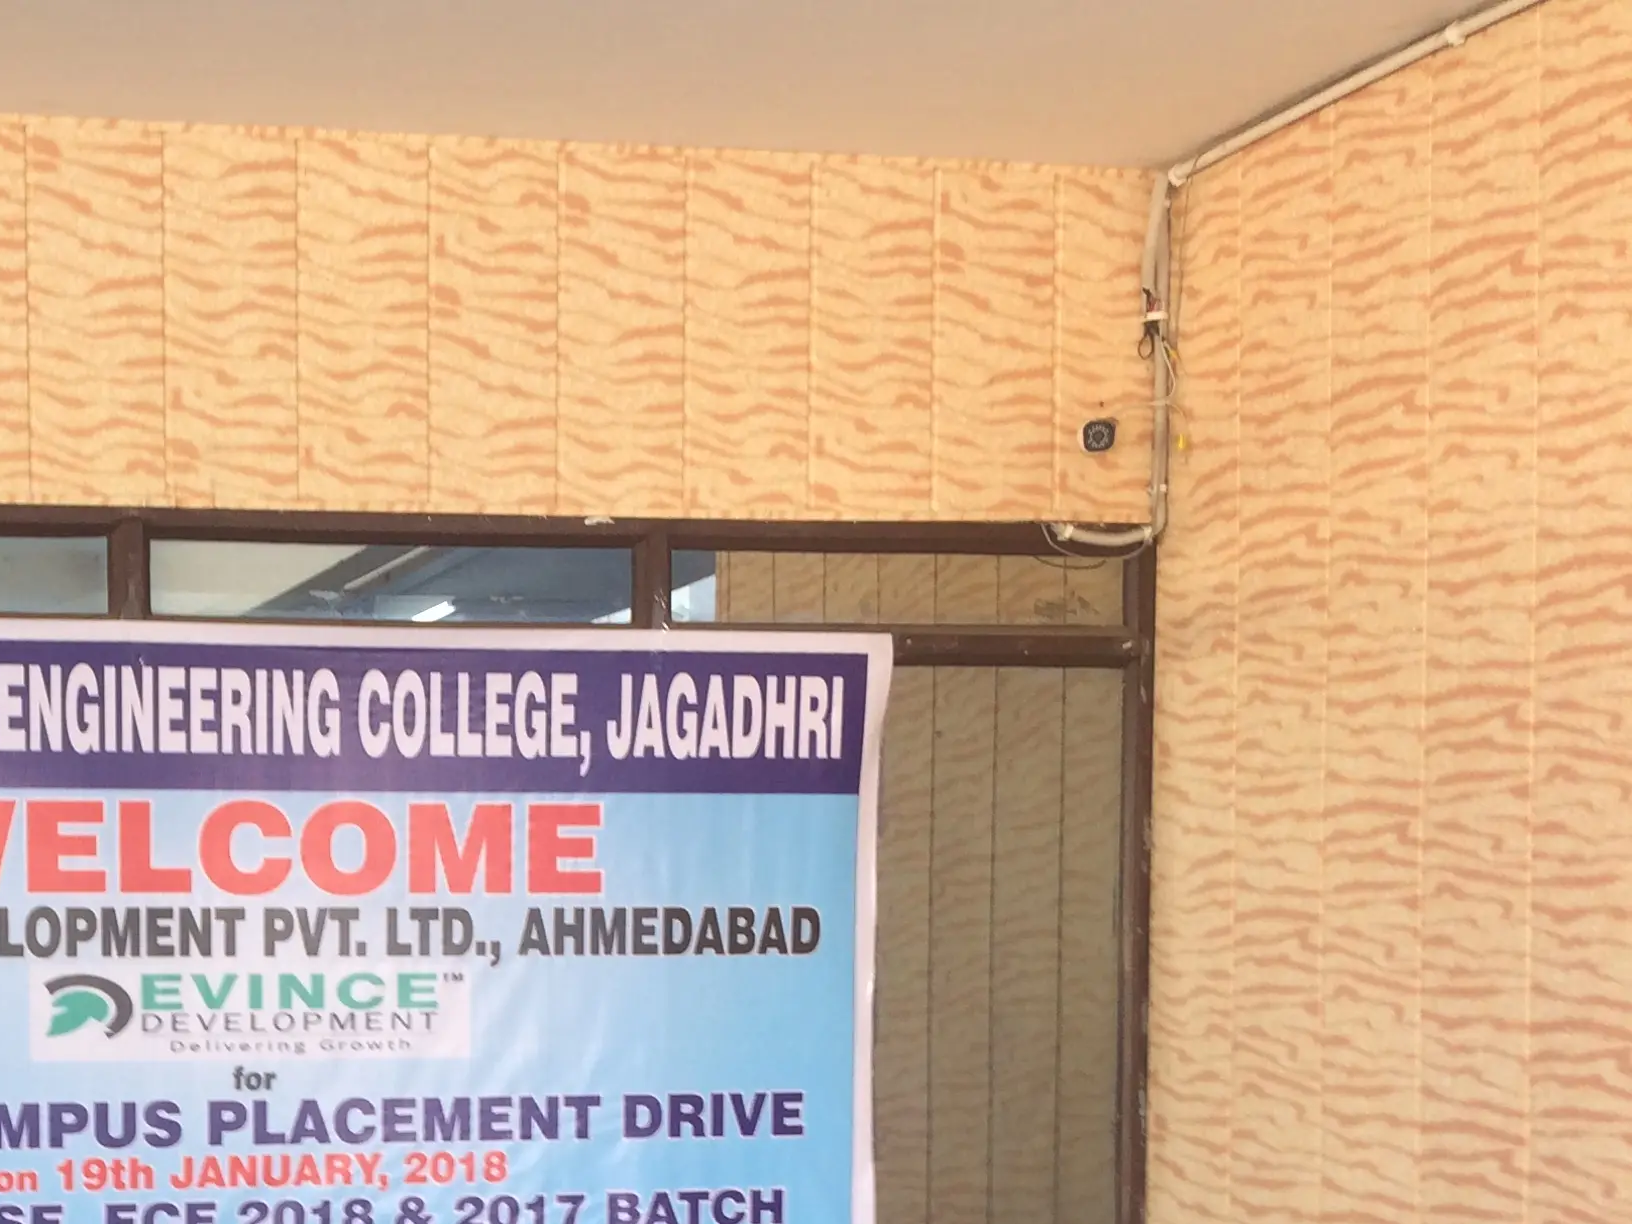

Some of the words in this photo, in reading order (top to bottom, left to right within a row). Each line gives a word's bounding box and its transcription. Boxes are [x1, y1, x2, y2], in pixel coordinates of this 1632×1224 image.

[358, 668, 592, 776] COLLEGE,
[606, 672, 845, 760] JAGADHRI
[264, 906, 367, 958] PVT.
[386, 906, 501, 964] LTD.,
[518, 906, 821, 957] AHMEDABAD
[140, 972, 439, 1010] EVINCE
[141, 1011, 439, 1034] DEVELOPMENT
[169, 1038, 307, 1054] Delivering
[319, 1037, 412, 1052] Growth
[233, 1066, 277, 1090] for
[207, 1095, 601, 1146] PLACEMENT
[622, 1092, 805, 1138] DRIVE
[56, 1157, 154, 1191] 19th
[170, 1152, 389, 1191] JANUARY,
[403, 1151, 508, 1185] 2018
